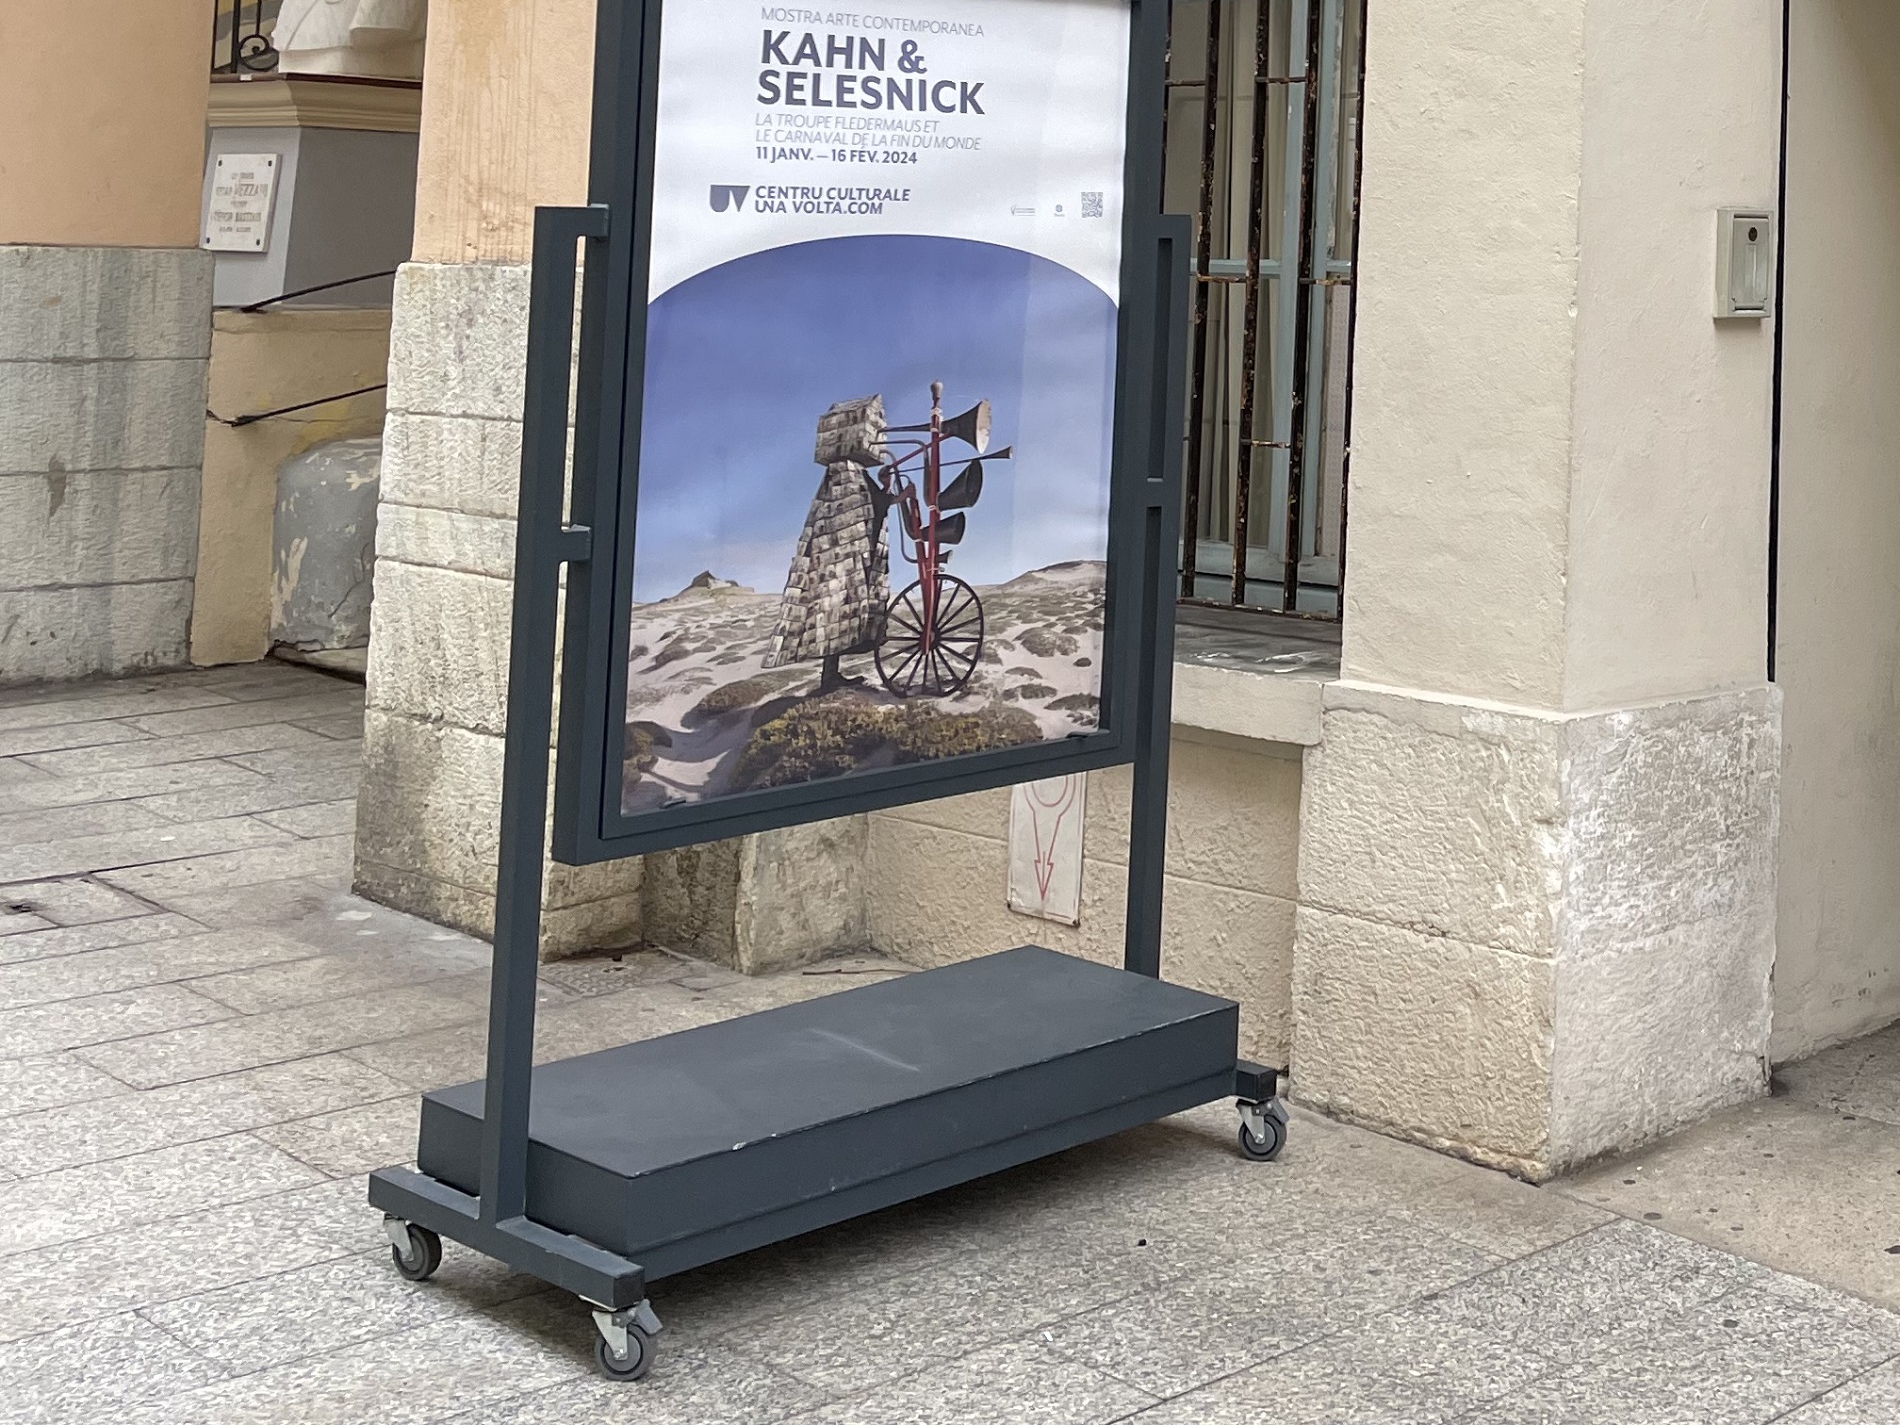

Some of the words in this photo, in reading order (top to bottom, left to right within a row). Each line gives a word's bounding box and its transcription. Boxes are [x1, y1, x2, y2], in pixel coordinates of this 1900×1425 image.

[760, 6, 823, 25] MOSTRA
[825, 12, 860, 28] ARTE
[862, 14, 985, 37] CONTEMPORANEA
[760, 29, 886, 72] KAHN
[897, 39, 928, 74] &
[756, 69, 986, 115] SELESNICK
[755, 112, 773, 126] LA
[775, 113, 831, 128] TROUPE
[833, 115, 921, 132] FLEDERMAUS
[923, 120, 941, 133] ET
[755, 129, 771, 142] LE
[774, 130, 849, 146] CARNAVAL
[851, 133, 869, 146] DE
[871, 134, 888, 147] LA
[889, 135, 910, 148] FIN
[911, 135, 932, 148] DU
[934, 136, 982, 151] MONDE
[755, 146, 768, 160] 11
[769, 147, 814, 163] JANV.
[831, 149, 847, 163] 16
[882, 150, 918, 165] 2024
[755, 185, 823, 200] CENTRU
[825, 187, 911, 202] CULTURALE
[754, 199, 787, 214] UNA
[792, 200, 884, 215] VOLTA.COM
